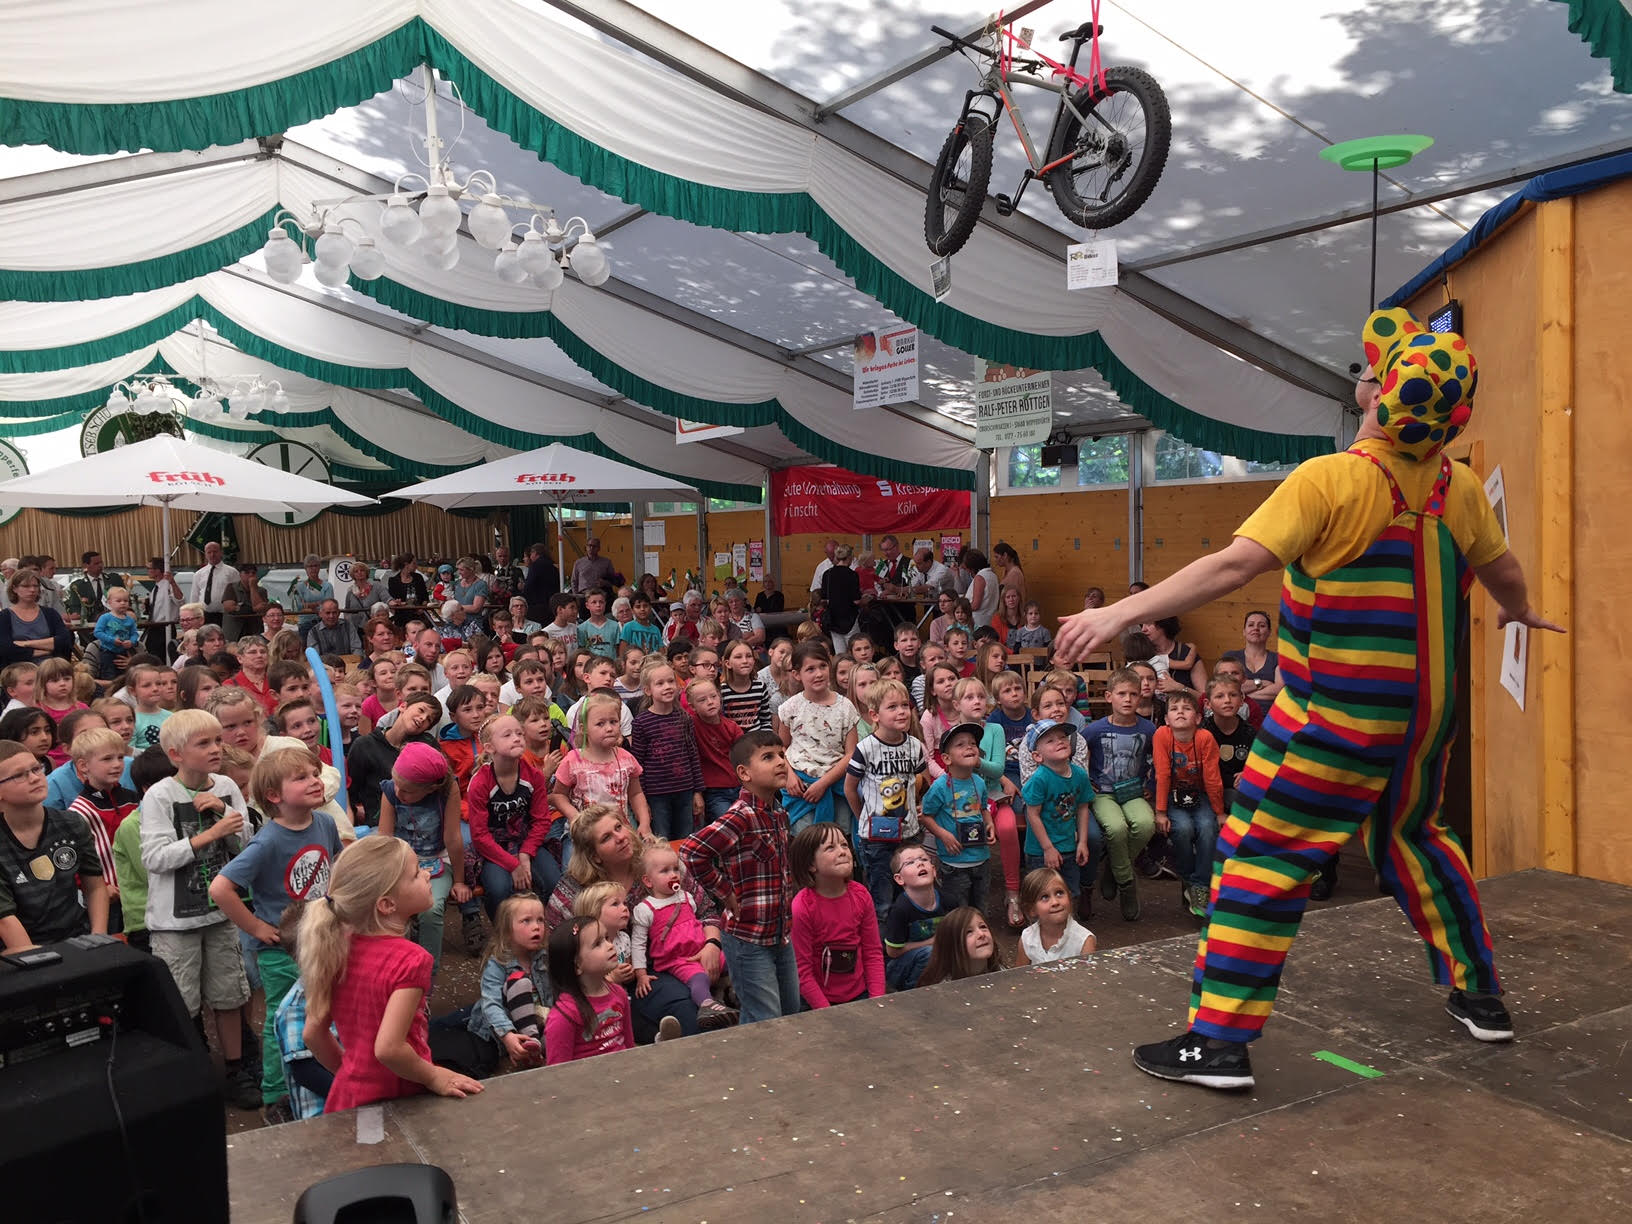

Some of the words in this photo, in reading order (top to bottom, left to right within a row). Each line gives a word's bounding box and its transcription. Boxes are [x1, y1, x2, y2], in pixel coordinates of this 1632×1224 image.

[978, 400, 1018, 418] RALF-PETER
[145, 471, 225, 486] Früh
[514, 473, 576, 483] Früh
[897, 501, 917, 516] Köln
[942, 536, 960, 544] DISCO
[632, 631, 660, 654] NYC
[883, 751, 906, 760] TEAM
